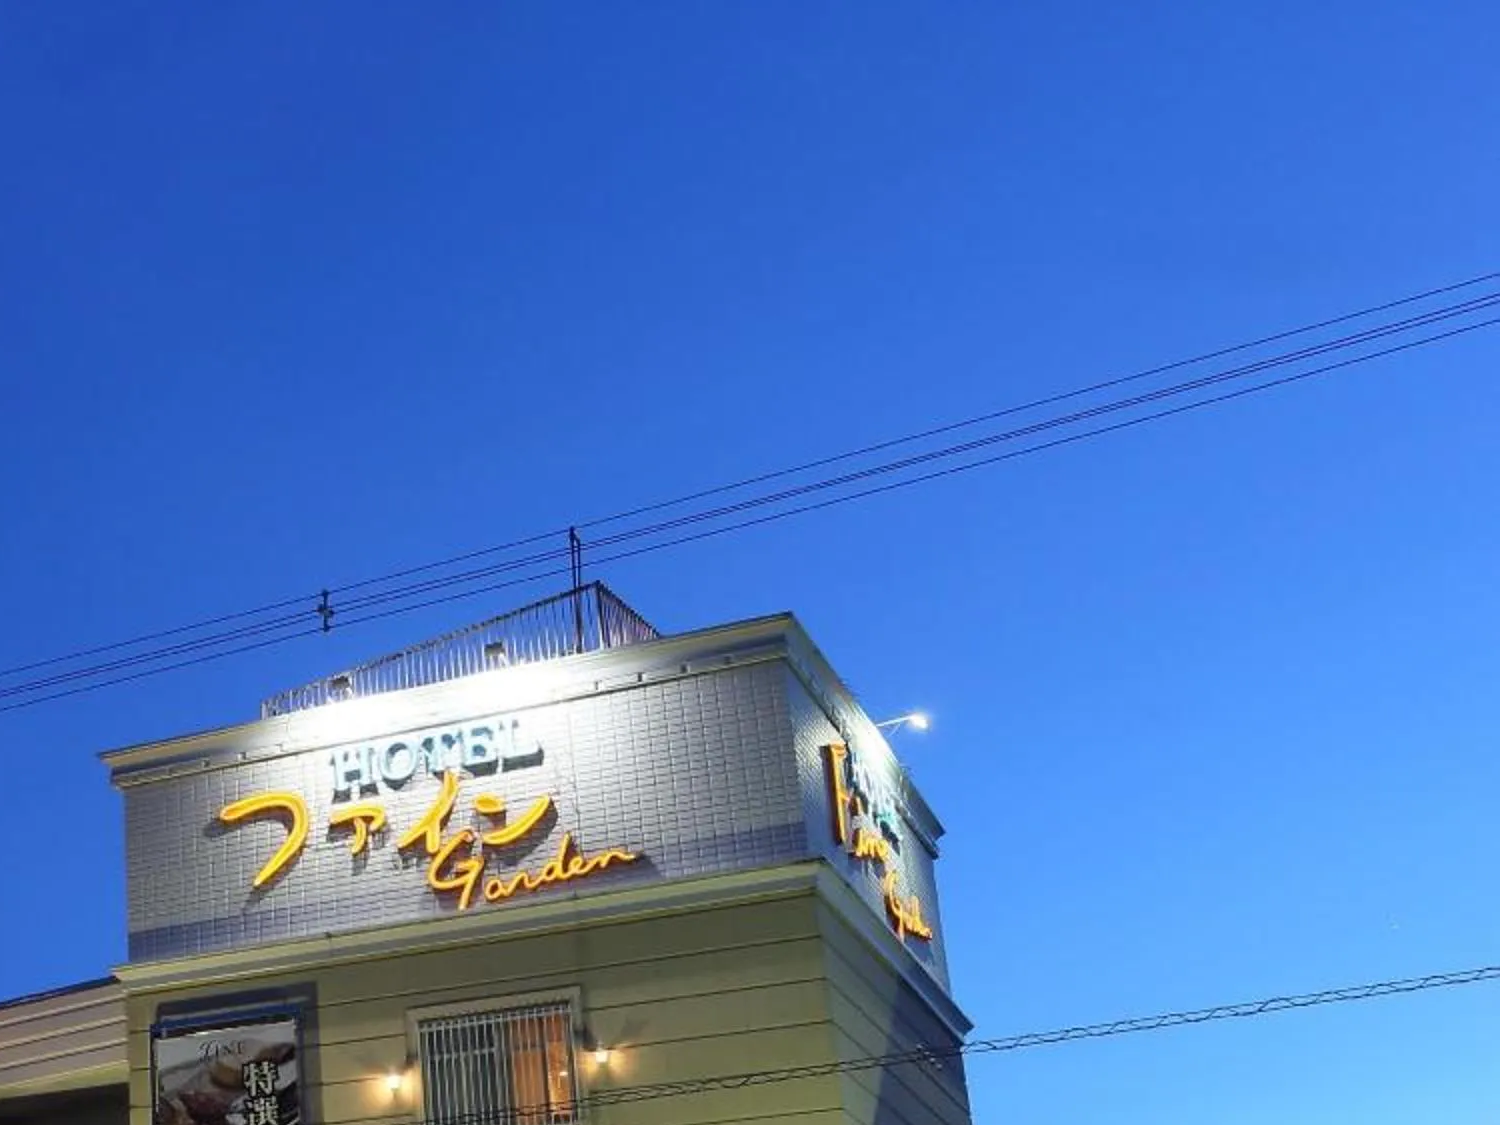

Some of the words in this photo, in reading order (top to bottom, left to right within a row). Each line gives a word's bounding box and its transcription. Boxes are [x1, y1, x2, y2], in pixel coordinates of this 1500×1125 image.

[331, 719, 544, 801] HOTEL
[219, 770, 557, 887] ファイン
[427, 831, 636, 911] Garden
